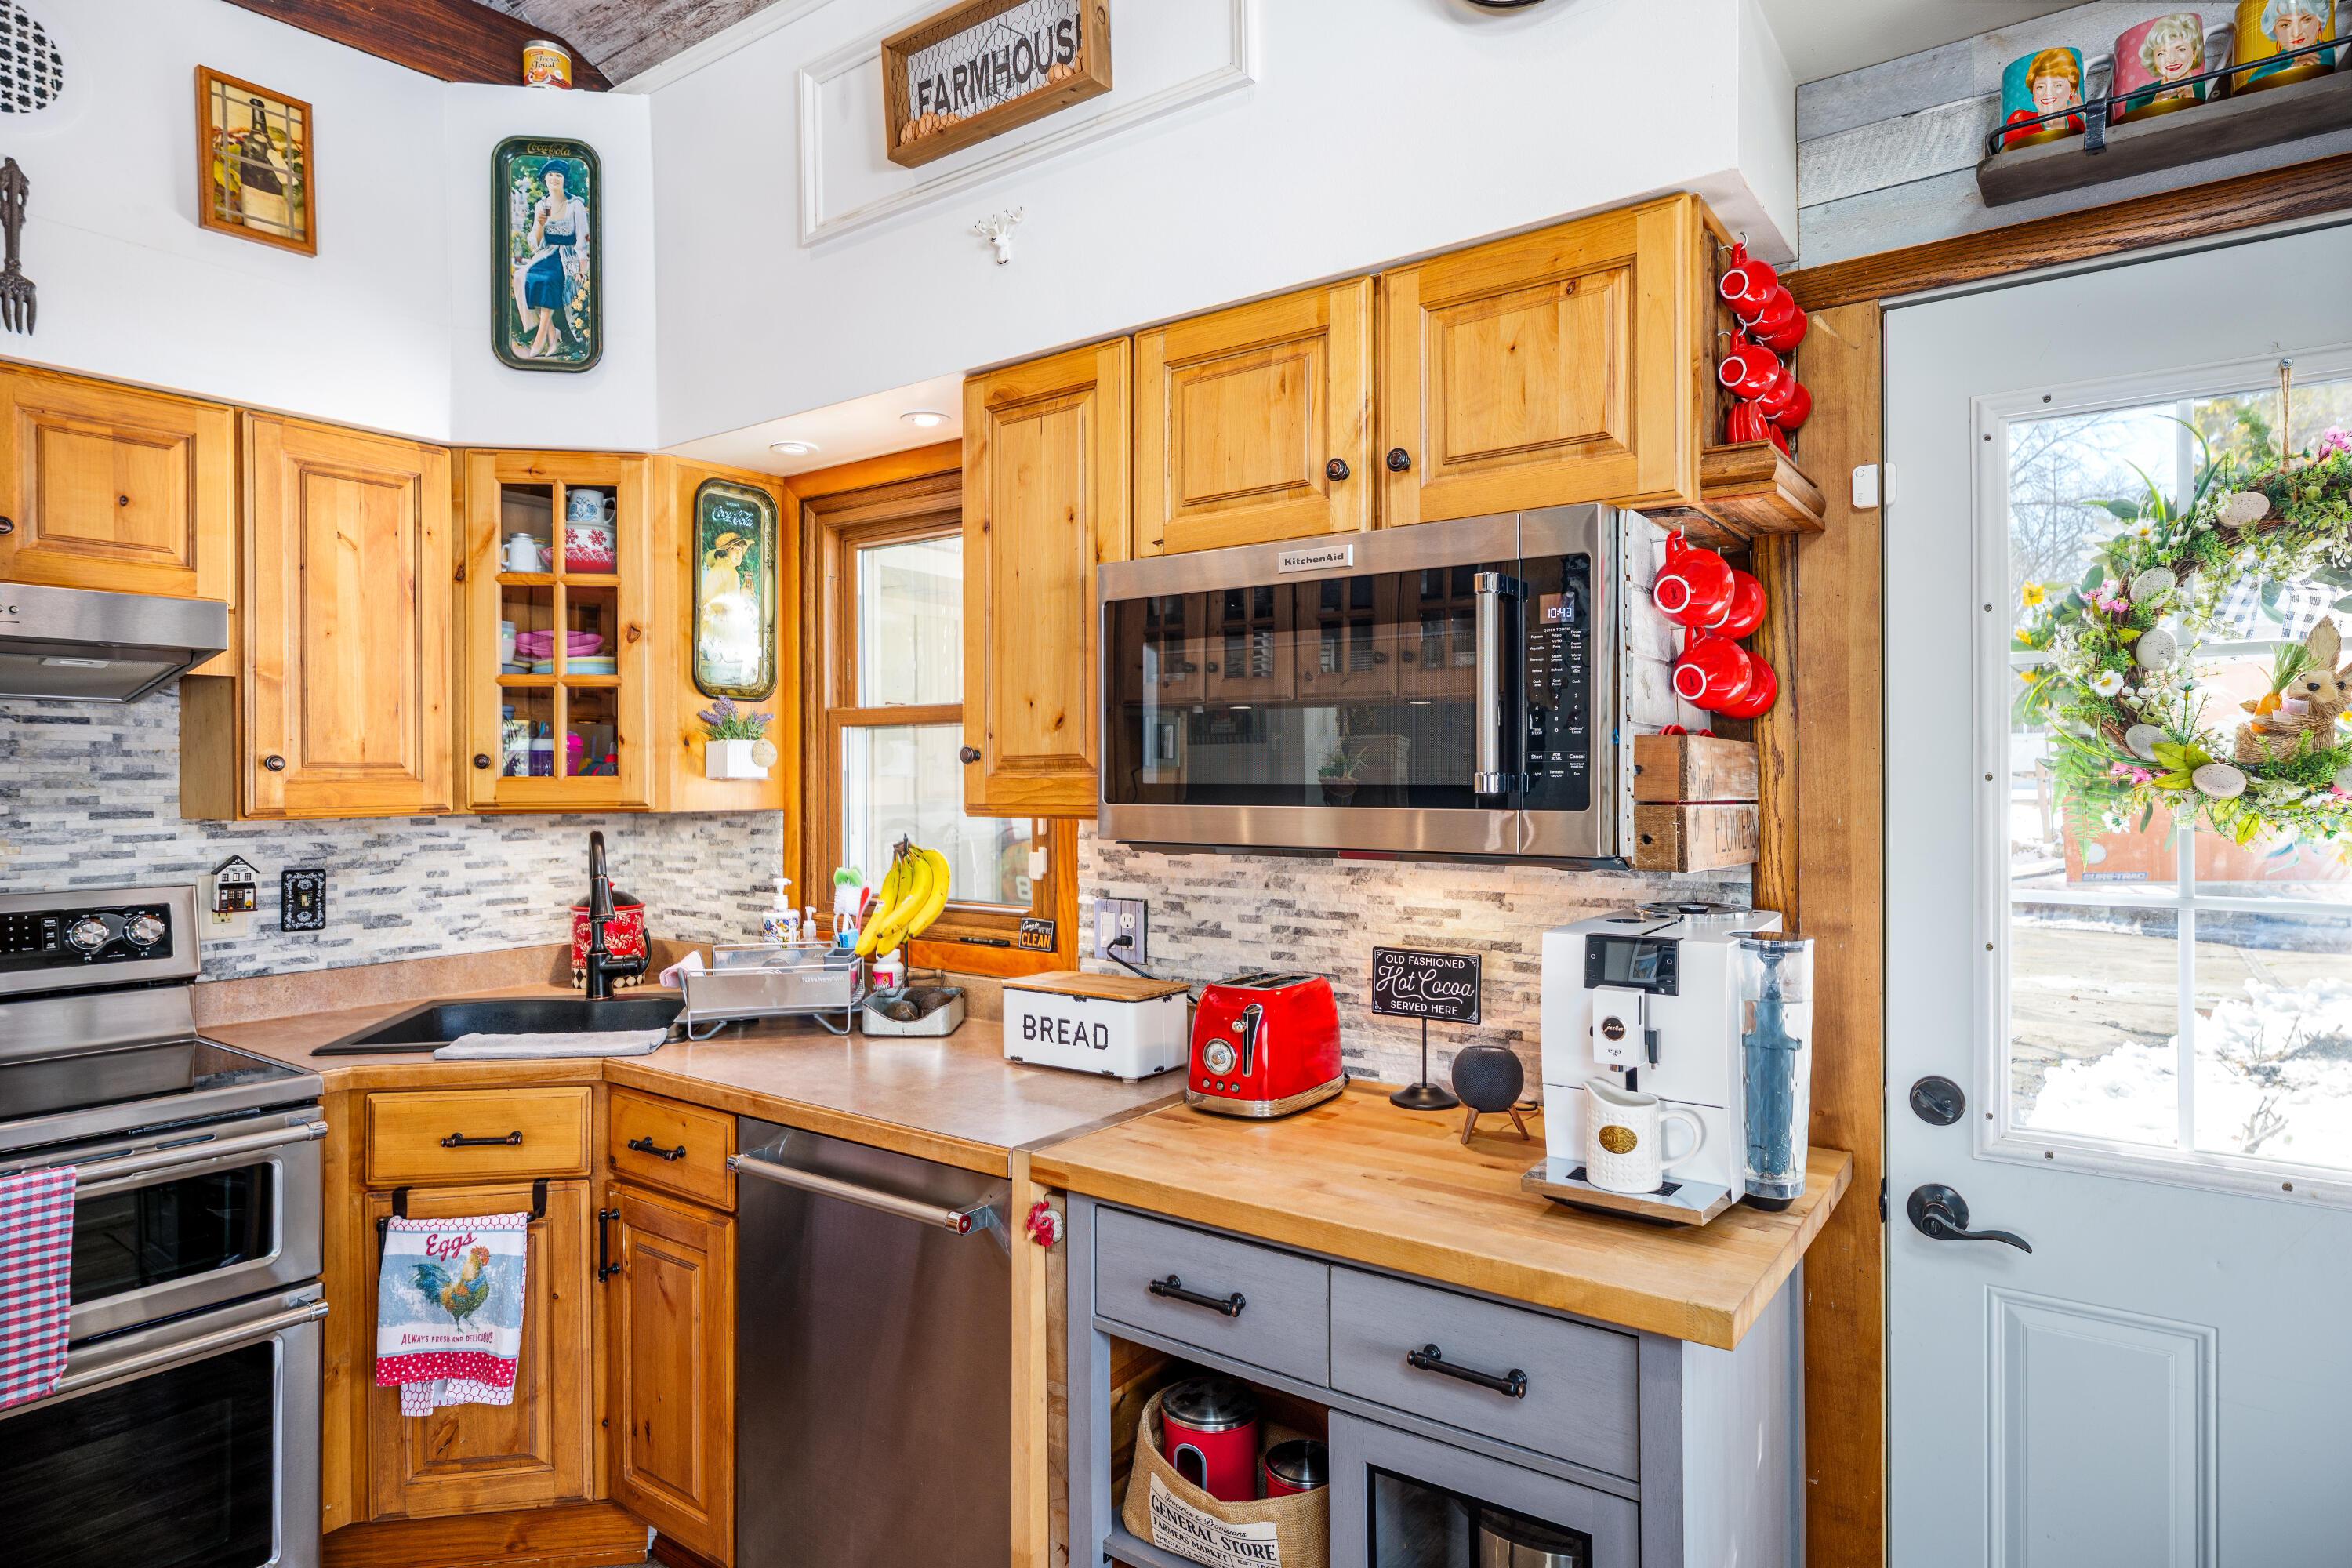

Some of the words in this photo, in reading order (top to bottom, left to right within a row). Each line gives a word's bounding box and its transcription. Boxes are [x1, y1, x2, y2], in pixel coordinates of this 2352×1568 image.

[1284, 552, 1345, 566] KitchenAid
[1548, 607, 1572, 619] 10:43
[1714, 805, 1757, 854] FLOWERS
[1021, 932, 1051, 949] CLEAN
[1385, 954, 1405, 964] OLD
[1408, 956, 1465, 969] FASHIONED
[1376, 965, 1424, 1002] Hot
[1417, 968, 1475, 1004] Cocoa
[1390, 1000, 1428, 1012] SERVED
[1431, 1004, 1458, 1015] HERE
[1022, 1013, 1109, 1051] BREAD
[426, 1232, 477, 1262] Eggs
[401, 1333, 429, 1345] ALWAYS
[466, 1331, 493, 1344] DELICIOUS
[1151, 1494, 1218, 1546] GENERAL
[1221, 1535, 1277, 1562] STORE
[1164, 1492, 1195, 1518] Groceries
[1203, 1517, 1248, 1538] Provisions
[1153, 1516, 1190, 1545] FARMERS
[1191, 1540, 1228, 1563] MARKET
[1155, 1533, 1192, 1555] SPECIALLY
